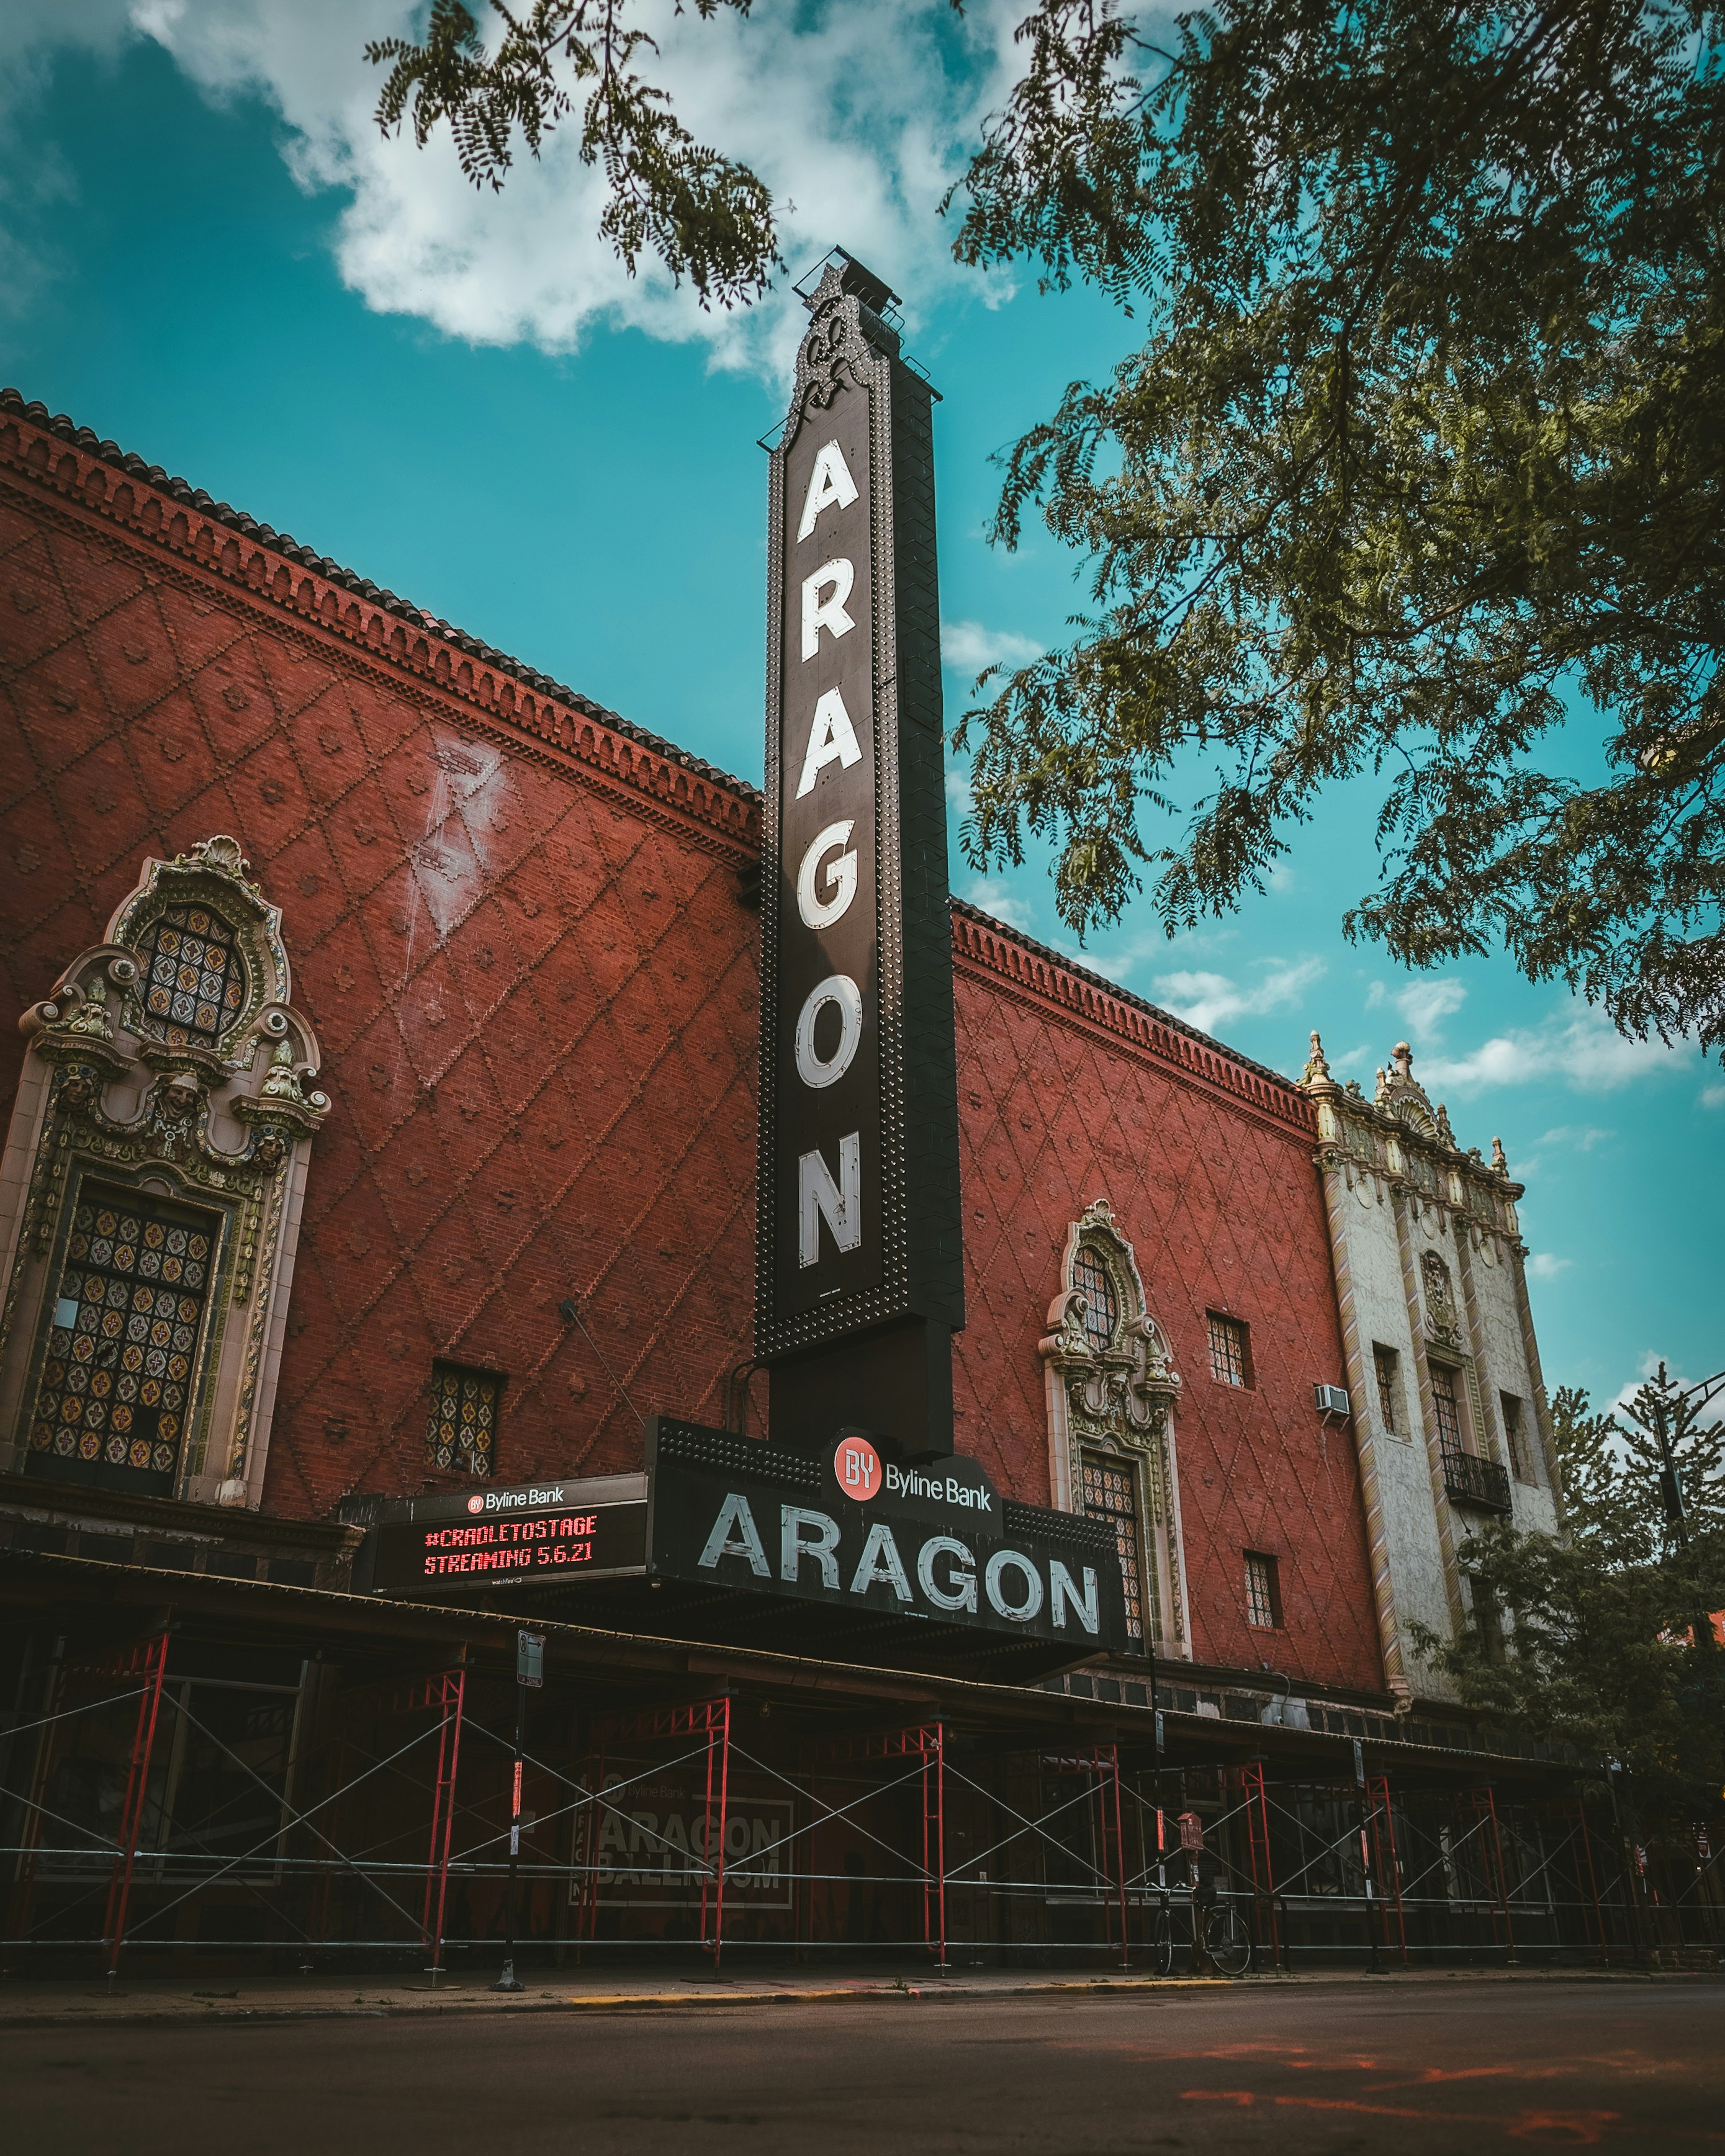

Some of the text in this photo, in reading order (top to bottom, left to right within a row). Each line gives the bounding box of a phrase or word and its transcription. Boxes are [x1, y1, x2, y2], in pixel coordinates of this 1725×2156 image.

[796, 439, 862, 1267] ARAGON
[846, 1449, 873, 1488] BY
[471, 1498, 482, 1511] BY
[486, 1486, 564, 1512] Byline Bank
[887, 1464, 992, 1512] Byline Bank
[425, 1515, 597, 1547] #CRADLETOSTAGE
[425, 1542, 592, 1574] STREAMING 5.6.21
[698, 1493, 1099, 1634] ARAGON
[628, 1784, 685, 1799] Byline Bank
[598, 1811, 780, 1857] ARAGON
